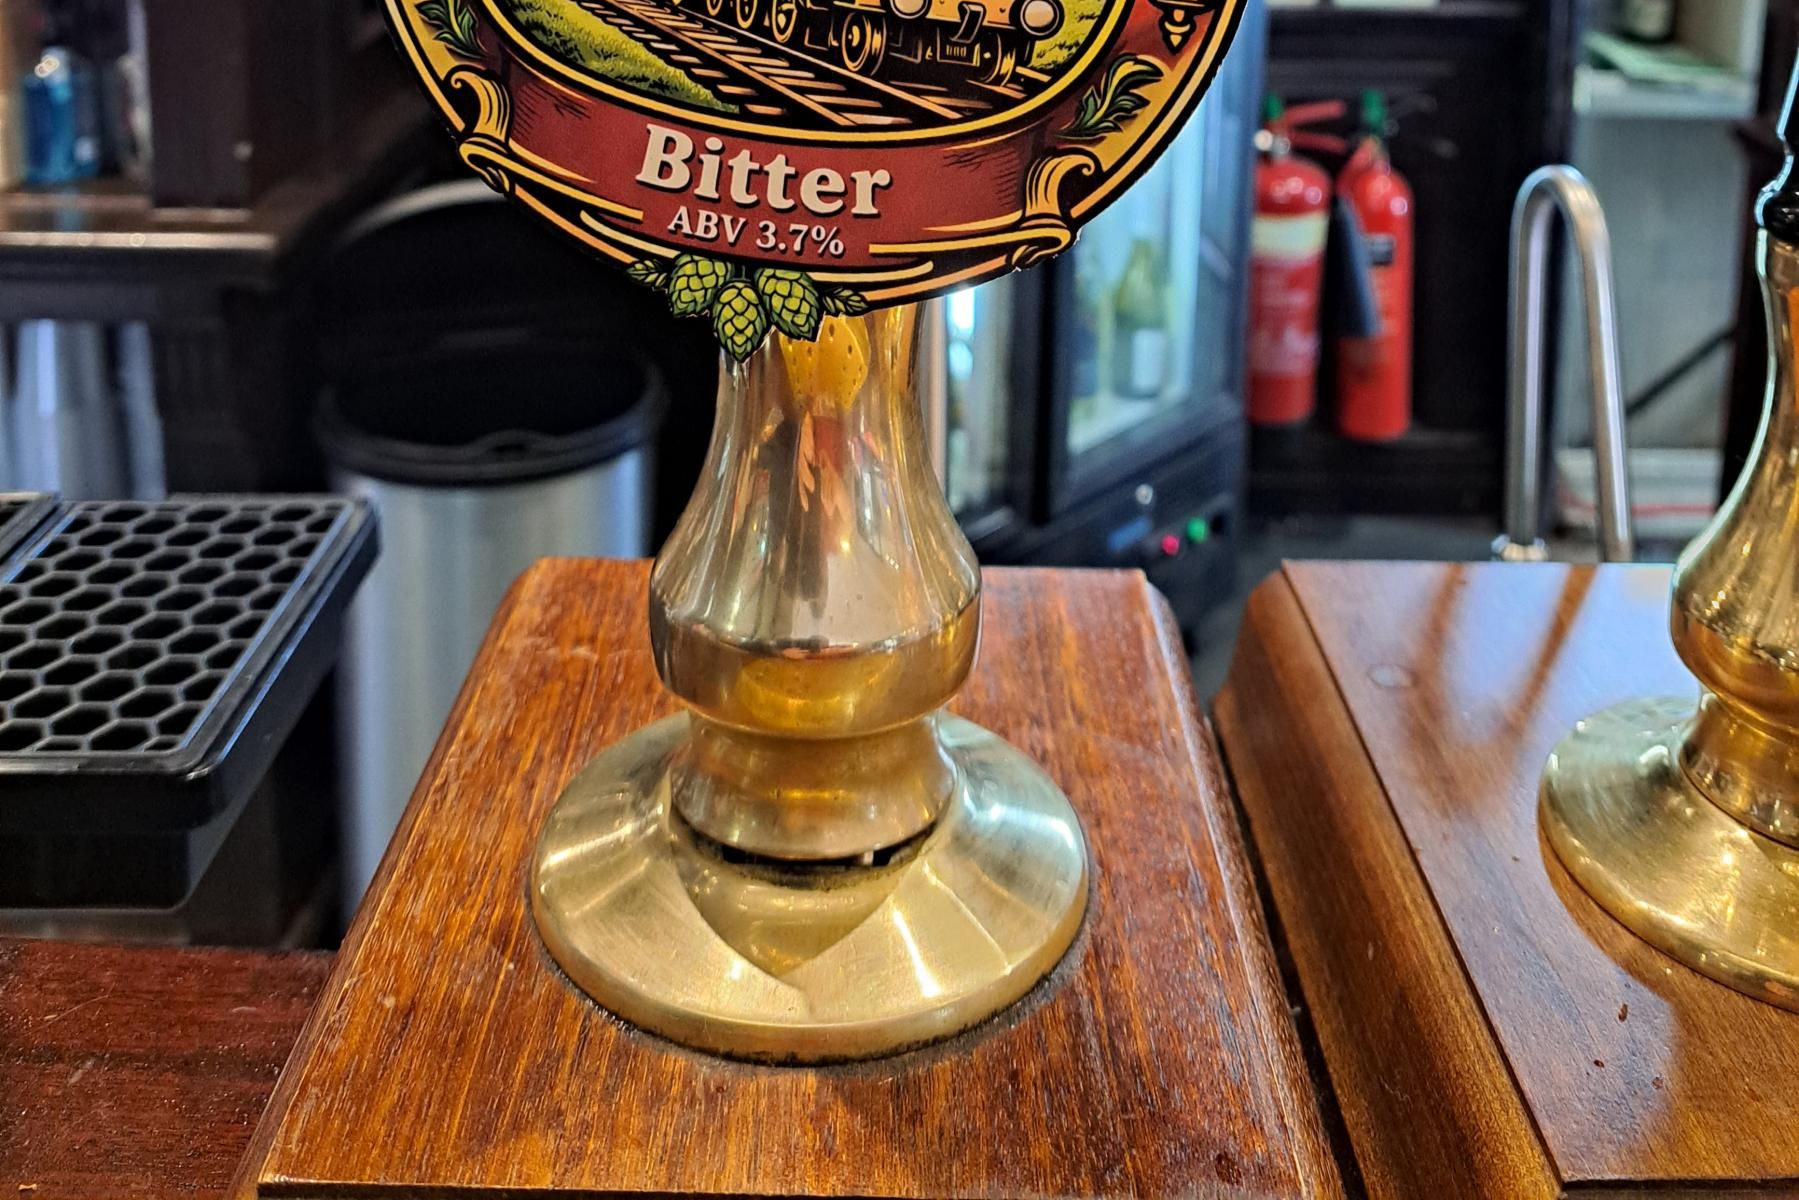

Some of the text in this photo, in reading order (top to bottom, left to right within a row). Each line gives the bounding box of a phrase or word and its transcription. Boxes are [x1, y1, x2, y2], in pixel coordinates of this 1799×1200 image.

[635, 123, 892, 216] Bitter
[667, 206, 845, 256] ABV 3.7%
